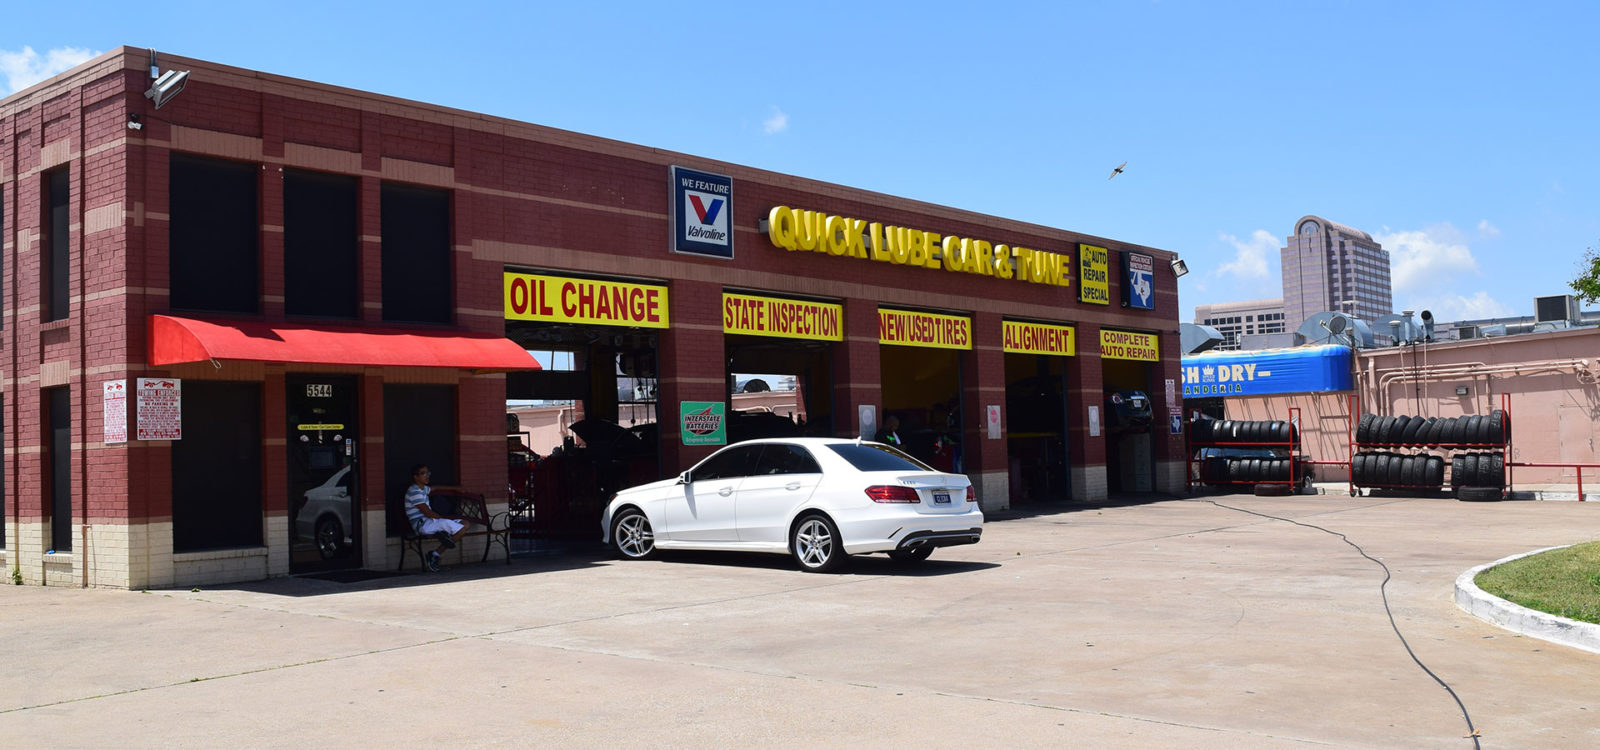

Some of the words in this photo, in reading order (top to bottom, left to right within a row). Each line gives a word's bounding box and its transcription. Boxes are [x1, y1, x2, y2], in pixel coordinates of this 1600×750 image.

[681, 178, 694, 188] WE
[695, 181, 729, 194] FEATURE
[687, 225, 726, 241] Valvoline
[768, 205, 868, 259] QUICK
[870, 222, 941, 269] LUBE
[942, 235, 994, 276] CAR
[1012, 247, 1070, 287] TUNE
[1092, 250, 1107, 265] AUTO
[1083, 268, 1106, 283] REPAIR
[510, 277, 553, 316] OIL
[561, 281, 660, 323] CHANGE
[1083, 286, 1108, 301] SPECIAL
[725, 297, 764, 331] STATE
[768, 301, 838, 336] INSPECTION
[1004, 324, 1070, 353] ALIGNMENT
[1103, 332, 1149, 347] COMPLETE
[1100, 344, 1125, 357] AUTO
[1126, 346, 1156, 360] REPAIR
[307, 384, 331, 397] 5544
[1185, 384, 1242, 395] ANDERIA
